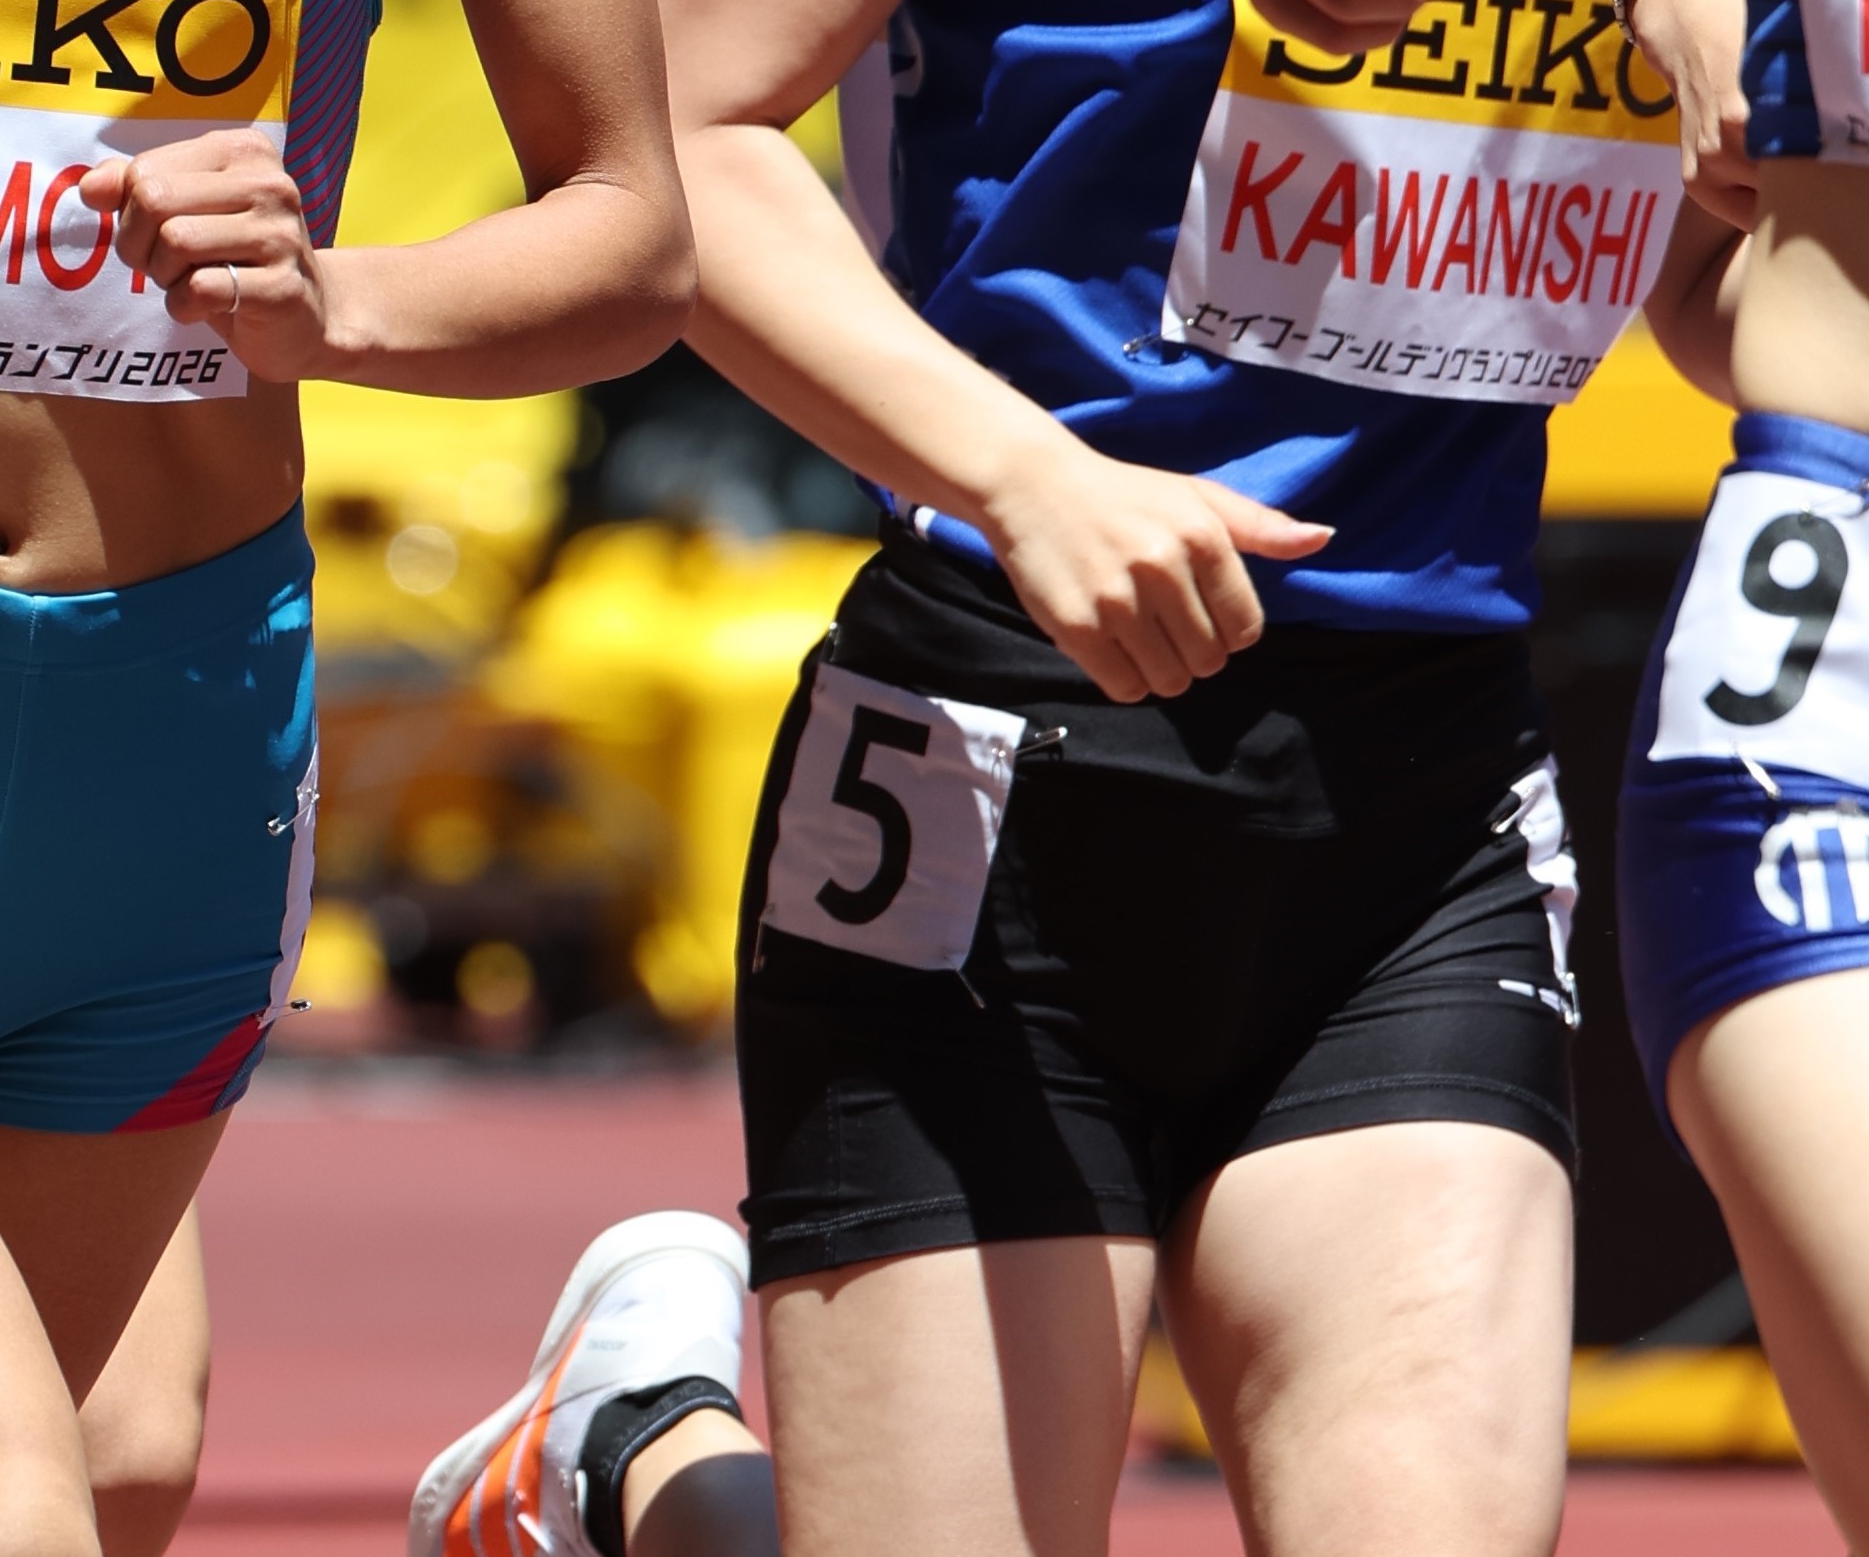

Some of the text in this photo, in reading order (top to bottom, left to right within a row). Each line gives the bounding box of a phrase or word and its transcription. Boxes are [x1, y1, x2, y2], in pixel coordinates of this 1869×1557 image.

[1220, 141, 1658, 306] KAWANISHI
[1703, 513, 1849, 727] 9
[815, 704, 930, 916] 5
